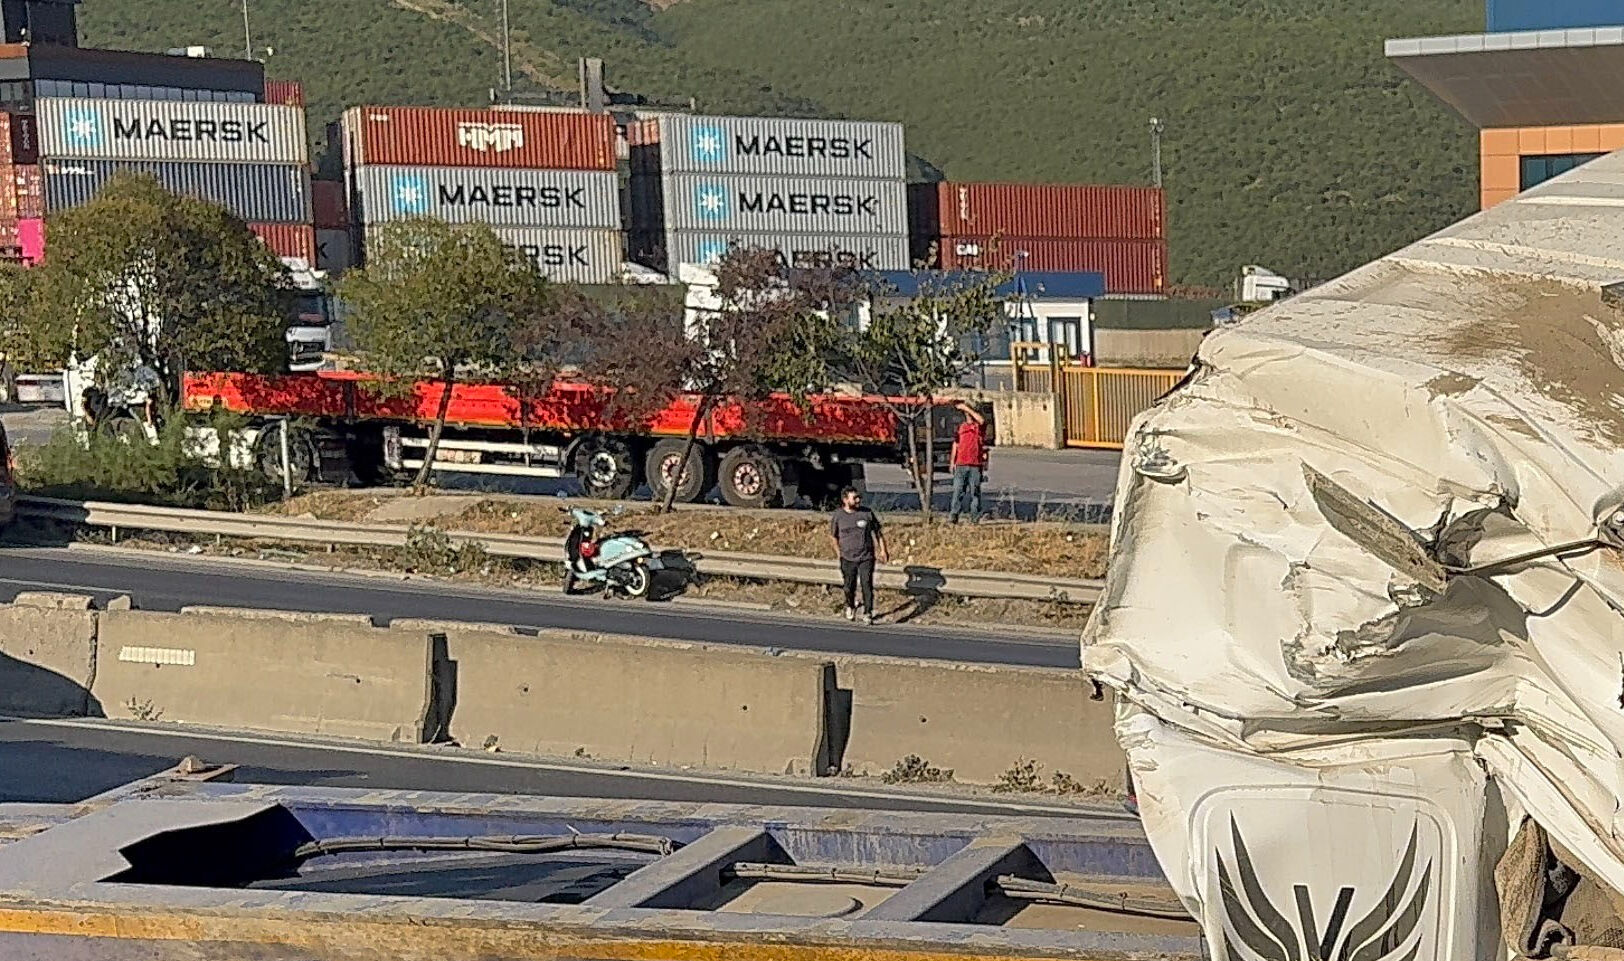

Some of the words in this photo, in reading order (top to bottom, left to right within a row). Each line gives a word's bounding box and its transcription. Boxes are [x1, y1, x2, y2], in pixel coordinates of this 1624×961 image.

[113, 118, 269, 143] MAERSK
[736, 135, 873, 159] MAERSK
[438, 184, 586, 208] MAERSK
[739, 193, 876, 215] MAERSK
